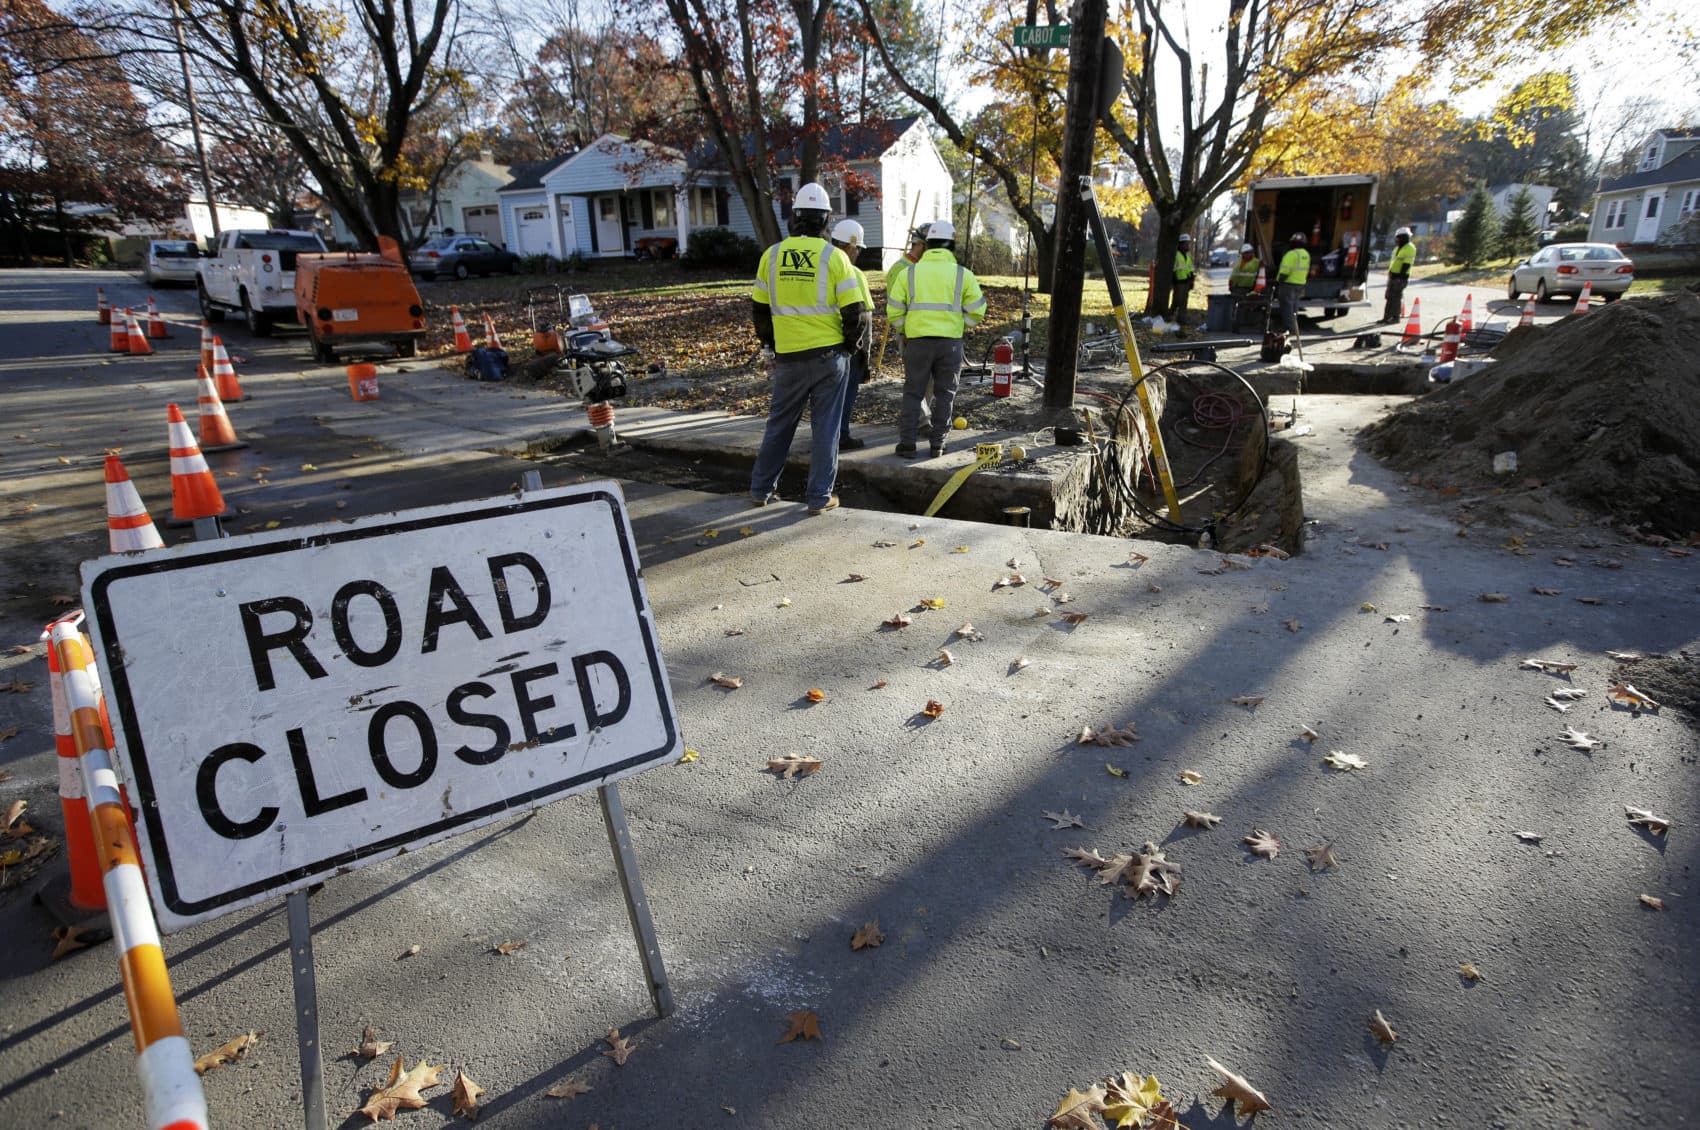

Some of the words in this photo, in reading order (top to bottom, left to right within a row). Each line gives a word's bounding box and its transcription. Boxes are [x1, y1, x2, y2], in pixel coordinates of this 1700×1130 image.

[1021, 27, 1054, 45] CABOT
[239, 551, 551, 691] ROAD
[196, 649, 632, 840] CLOSED
